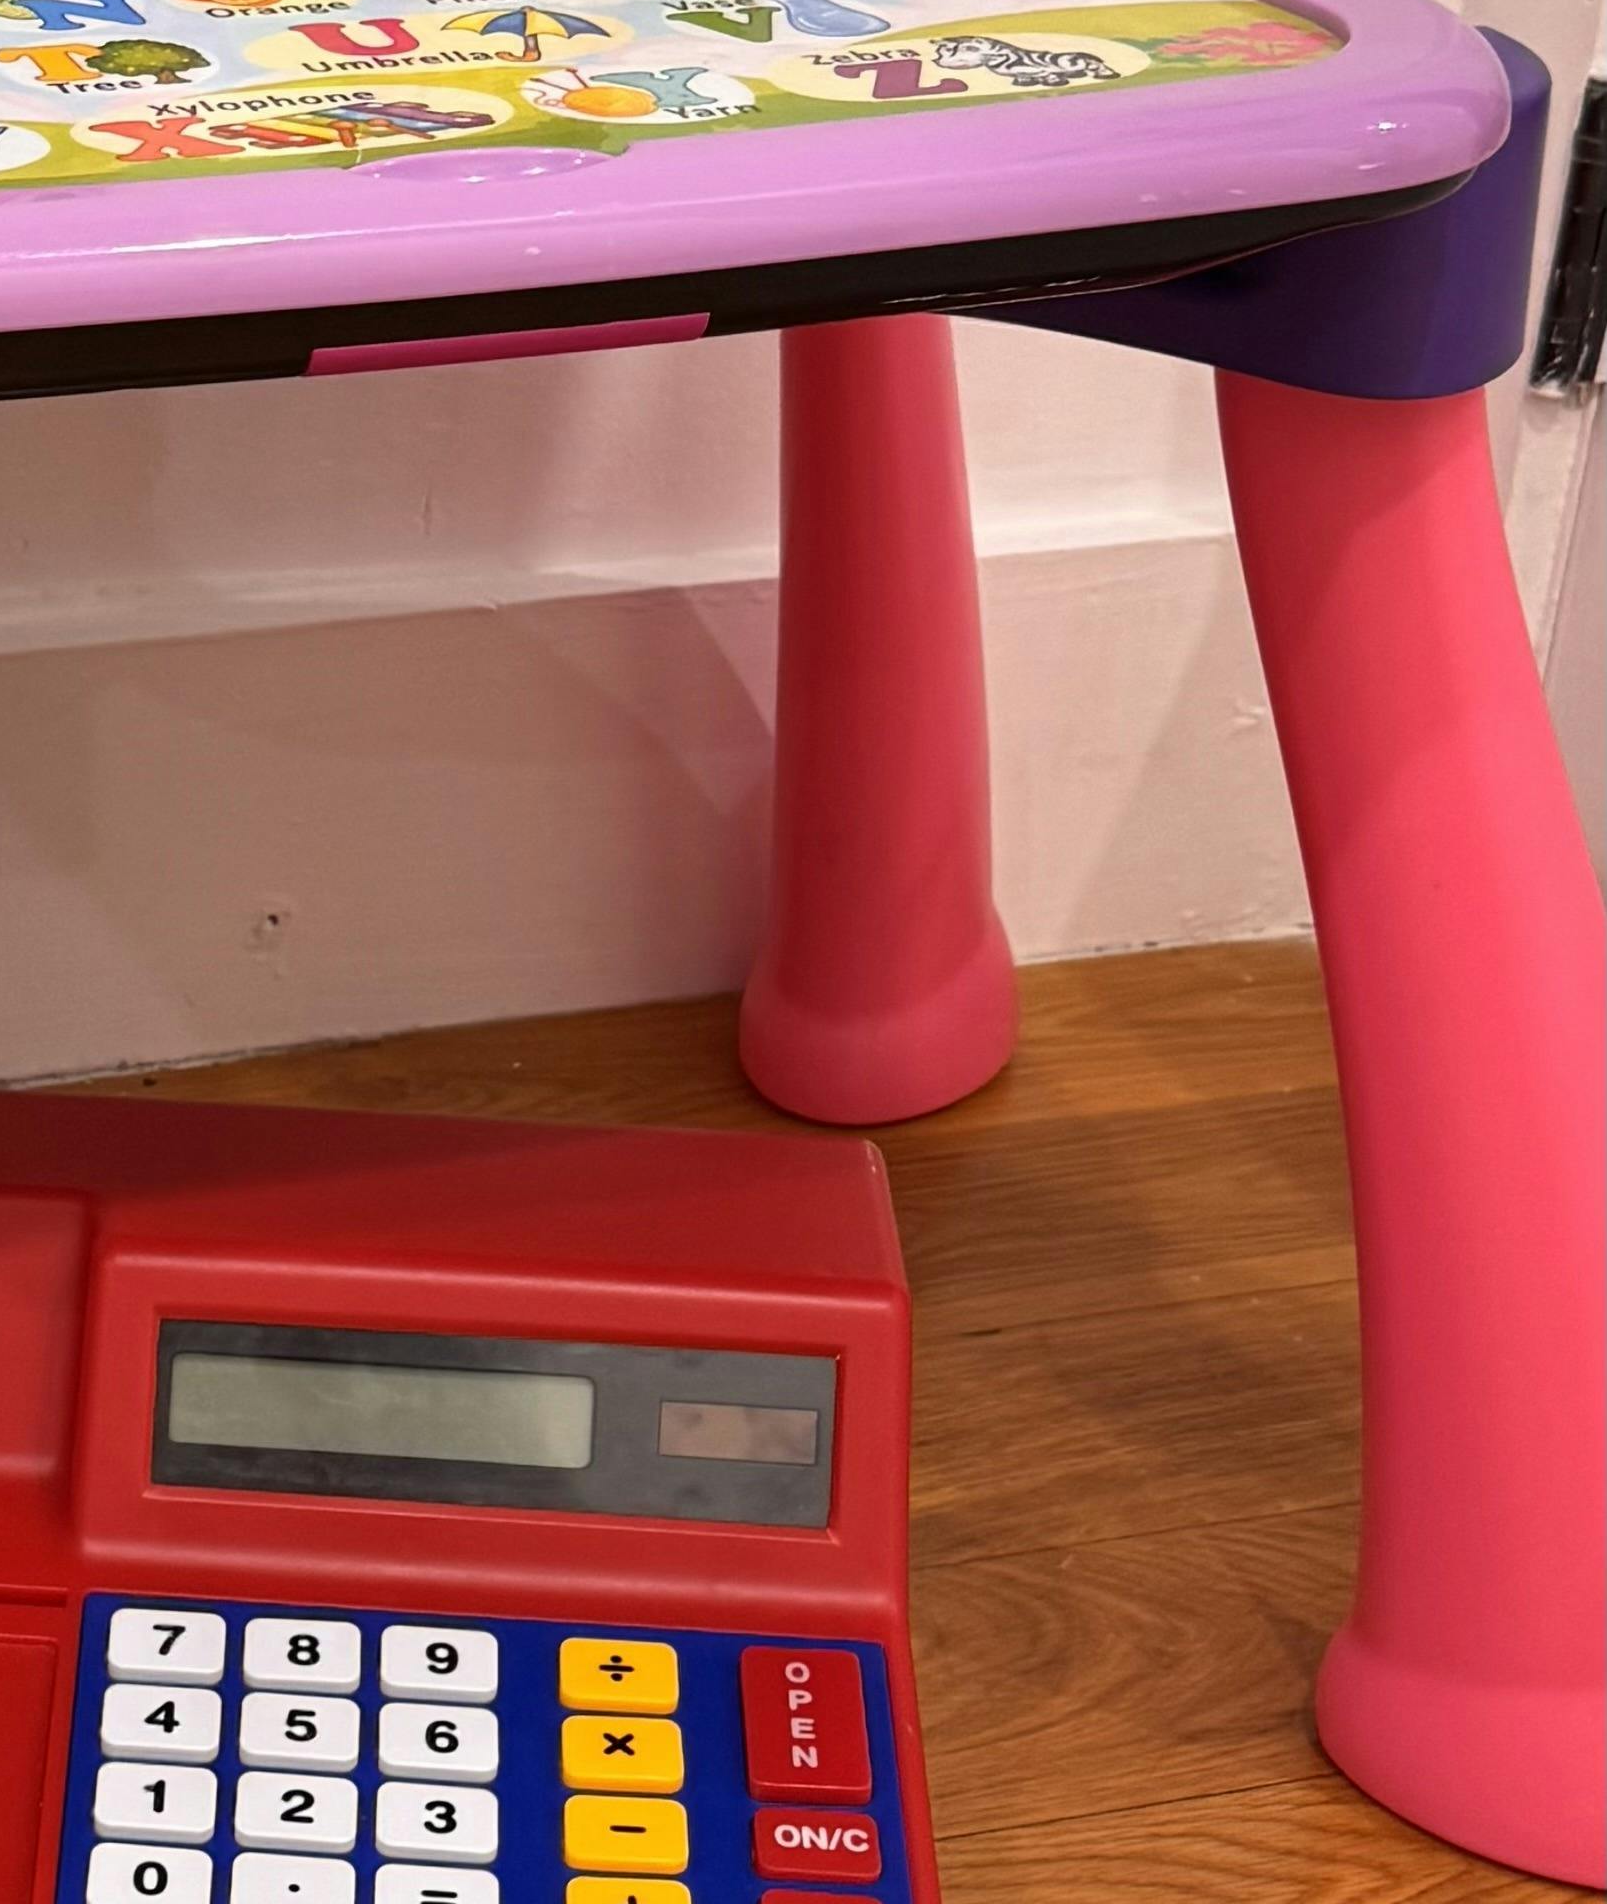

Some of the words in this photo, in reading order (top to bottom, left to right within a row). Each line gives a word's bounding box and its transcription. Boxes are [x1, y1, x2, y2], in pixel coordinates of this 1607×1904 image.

[206, 2, 350, 18] Orange
[666, 6, 782, 43] V
[289, 18, 419, 55] U
[302, 50, 493, 73] Umbrella
[802, 49, 921, 65] Zebra
[47, 80, 142, 94] Tree
[589, 67, 718, 107] Y
[834, 59, 968, 99] Z
[148, 90, 376, 116] Xylophone
[664, 105, 763, 119] Yarn
[89, 117, 246, 162] X
[152, 1624, 186, 1656] 7
[287, 1634, 320, 1666] 8
[424, 1642, 459, 1675] 9
[144, 1701, 180, 1733] 4
[284, 1709, 317, 1741] 5
[784, 1662, 818, 1768] OPEN
[425, 1720, 459, 1754] 6
[143, 1780, 166, 1813] 1
[280, 1790, 316, 1824] 2
[424, 1800, 457, 1834] 3
[774, 1823, 870, 1852] ON/C
[133, 1861, 169, 1896] 0
